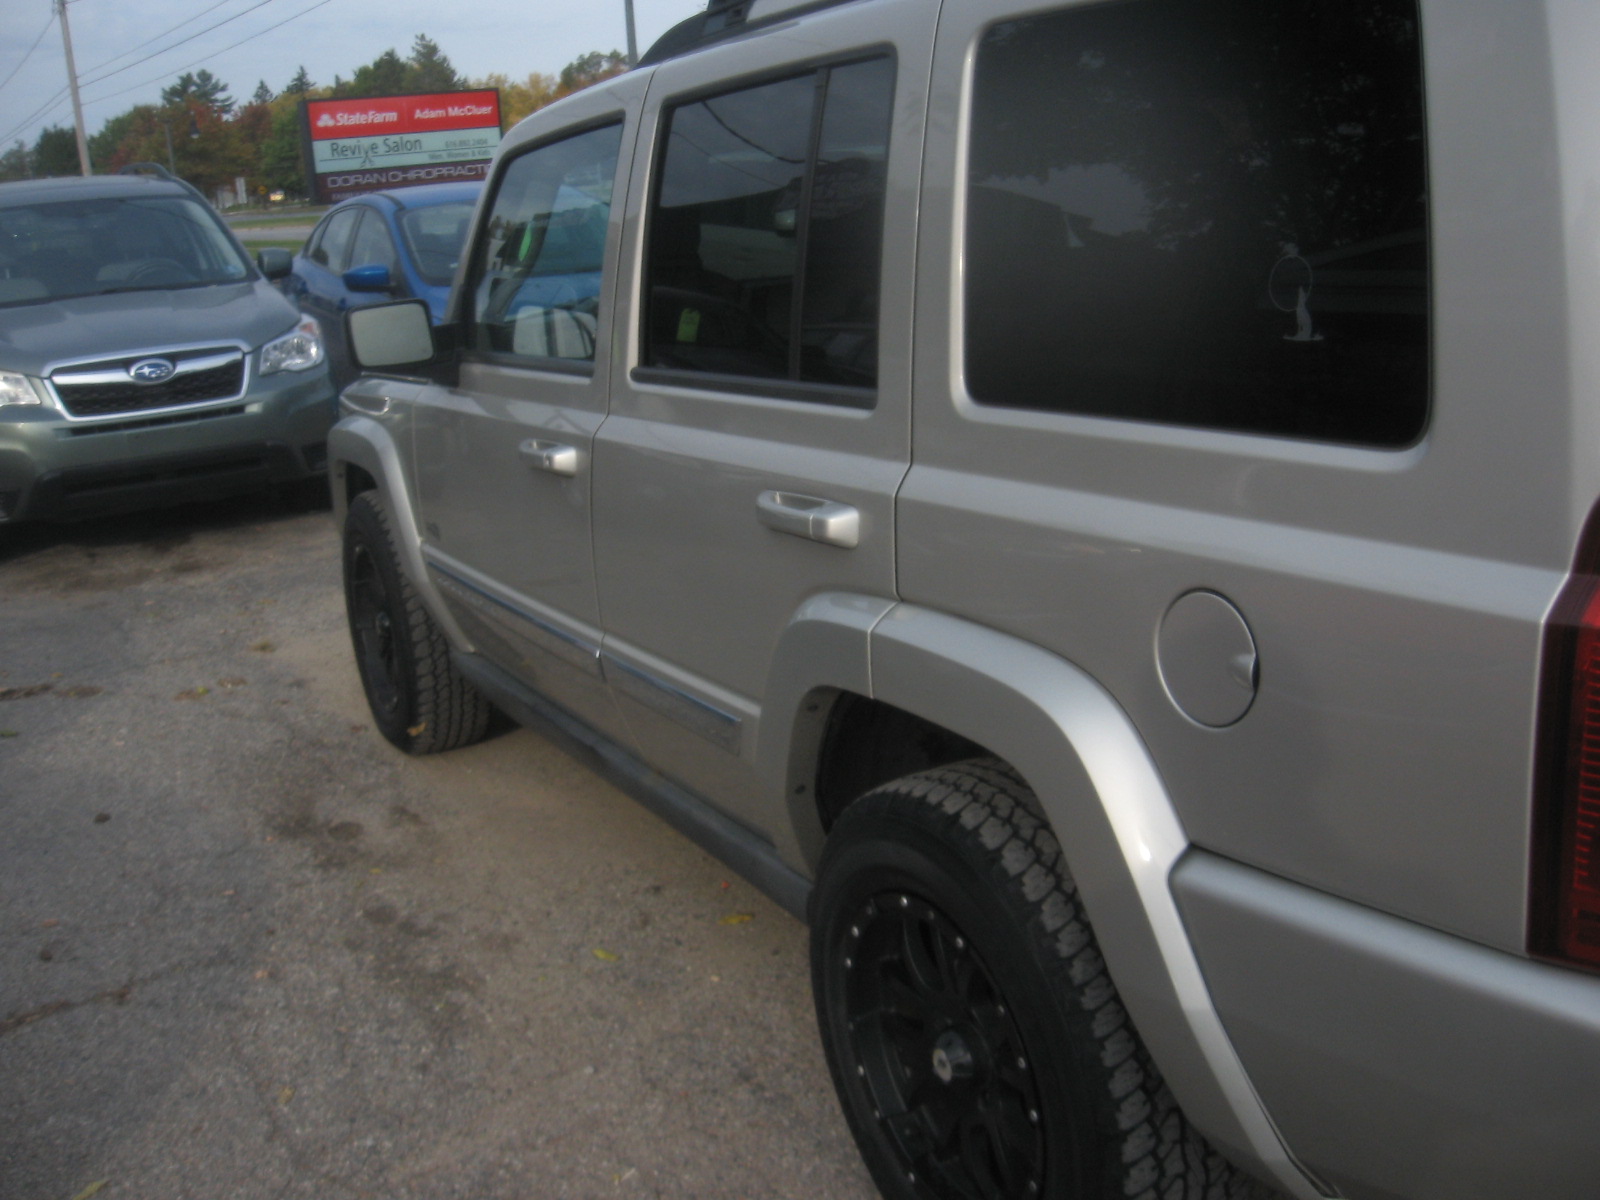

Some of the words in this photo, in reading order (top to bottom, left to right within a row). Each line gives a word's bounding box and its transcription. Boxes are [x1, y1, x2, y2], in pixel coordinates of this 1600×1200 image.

[336, 110, 398, 126] StateFarm
[414, 108, 446, 120] Adam
[448, 105, 493, 118] McCluer
[331, 139, 379, 158] Revive
[383, 136, 423, 153] Salon
[327, 172, 387, 188] DORAN
[388, 163, 491, 182] CHIROPRACTI
